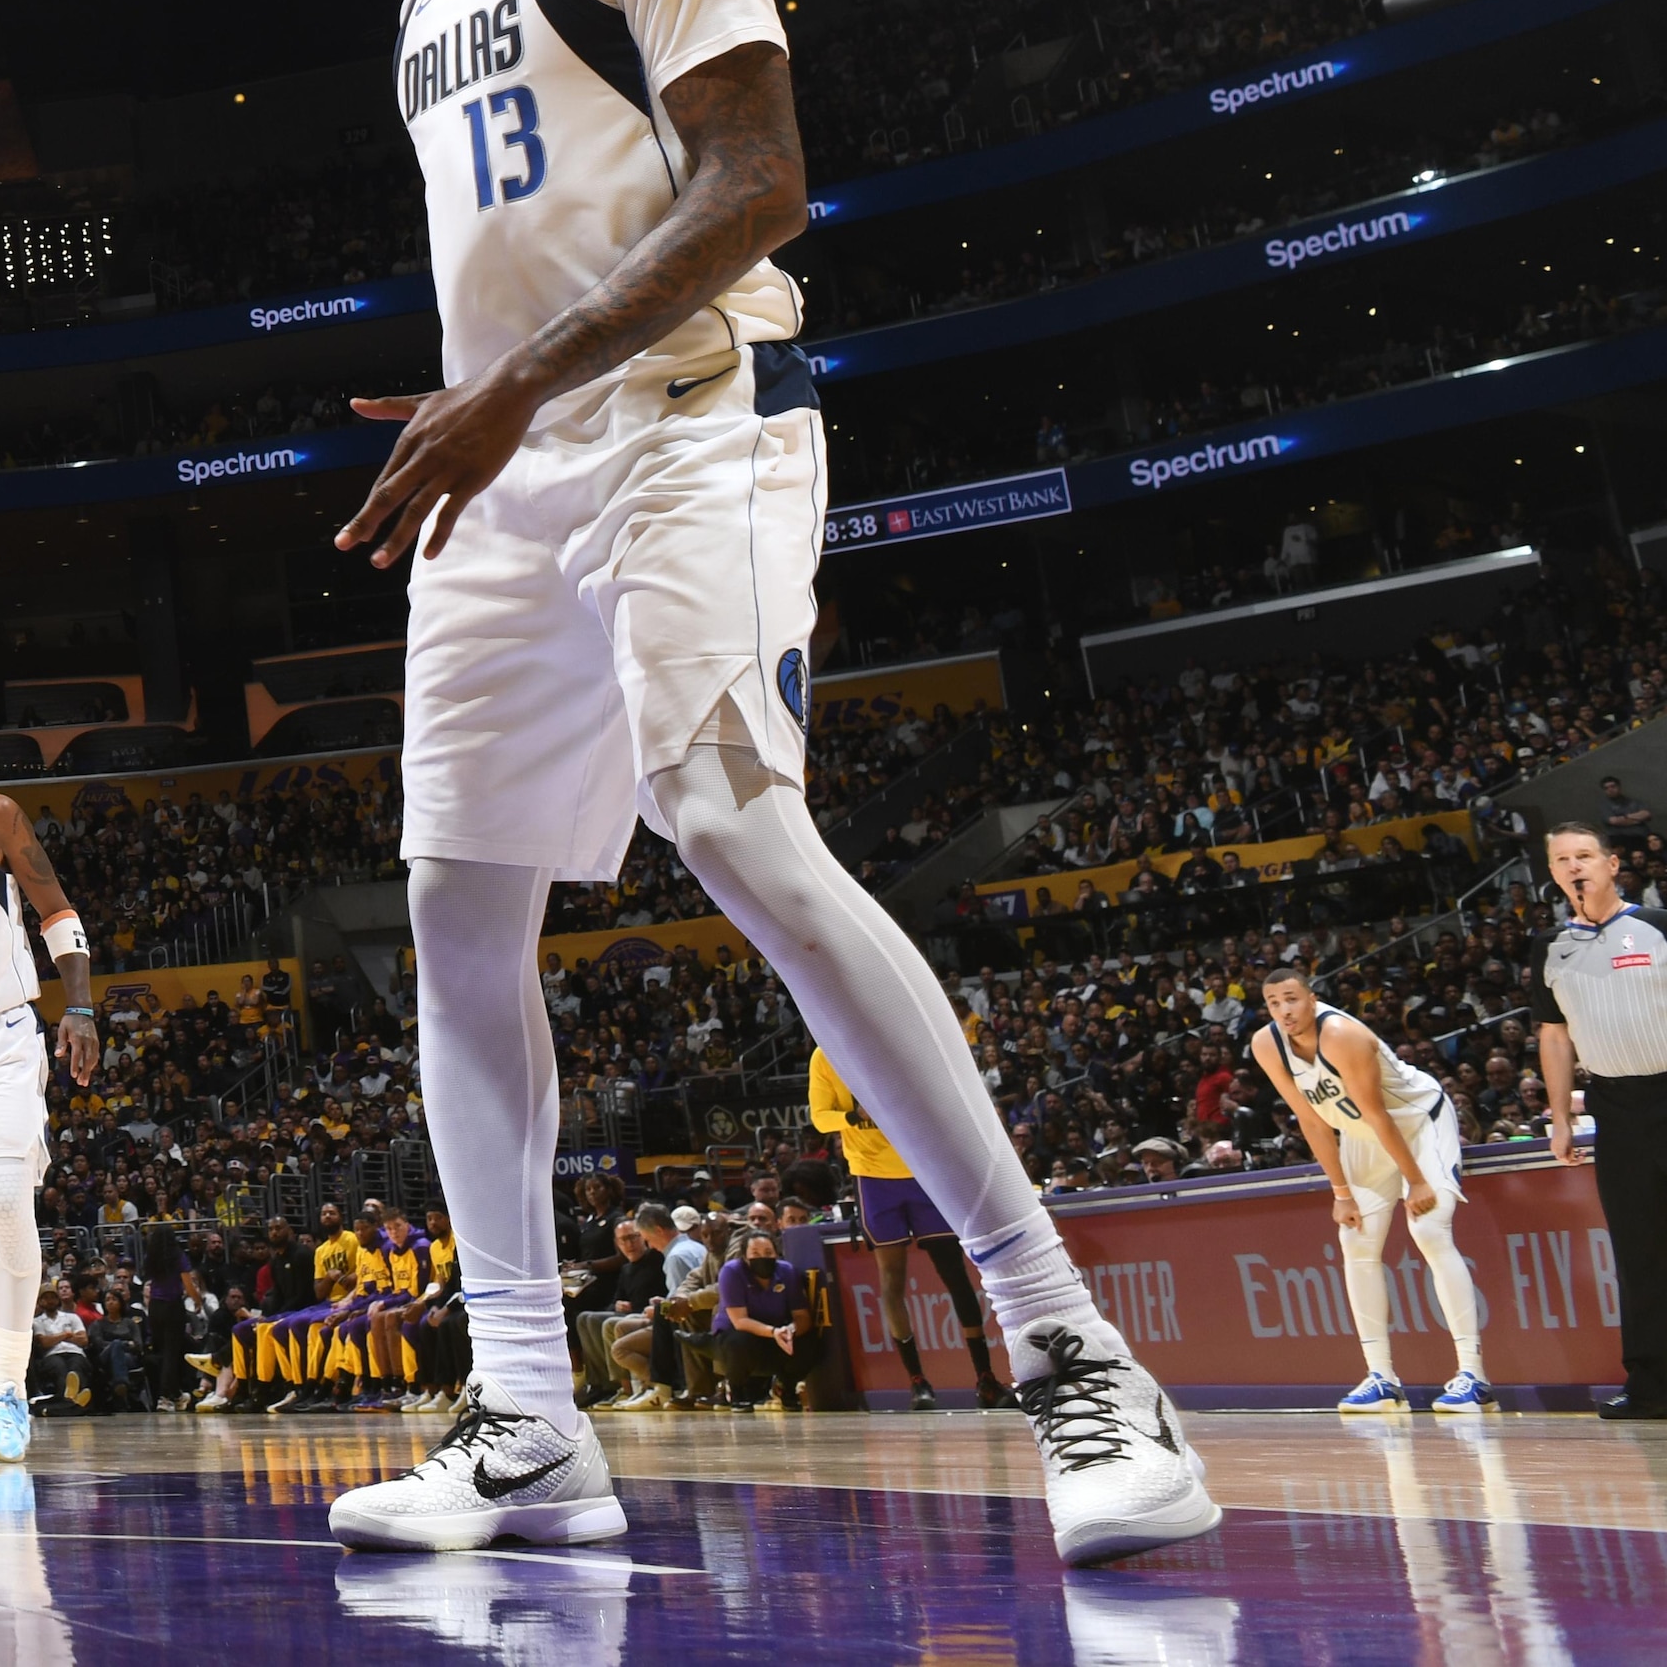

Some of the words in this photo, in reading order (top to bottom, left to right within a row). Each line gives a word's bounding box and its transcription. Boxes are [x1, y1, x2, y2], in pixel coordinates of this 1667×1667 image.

[1210, 59, 1335, 115] Spectrum
[462, 83, 548, 213] 13
[1265, 210, 1411, 270] Spectrum
[249, 296, 357, 332] Spectrum
[176, 448, 296, 487] Spectrum
[1129, 433, 1281, 489] Spectrum
[1091, 1260, 1182, 1343] ETTER
[1507, 1230, 1577, 1330] FLY
